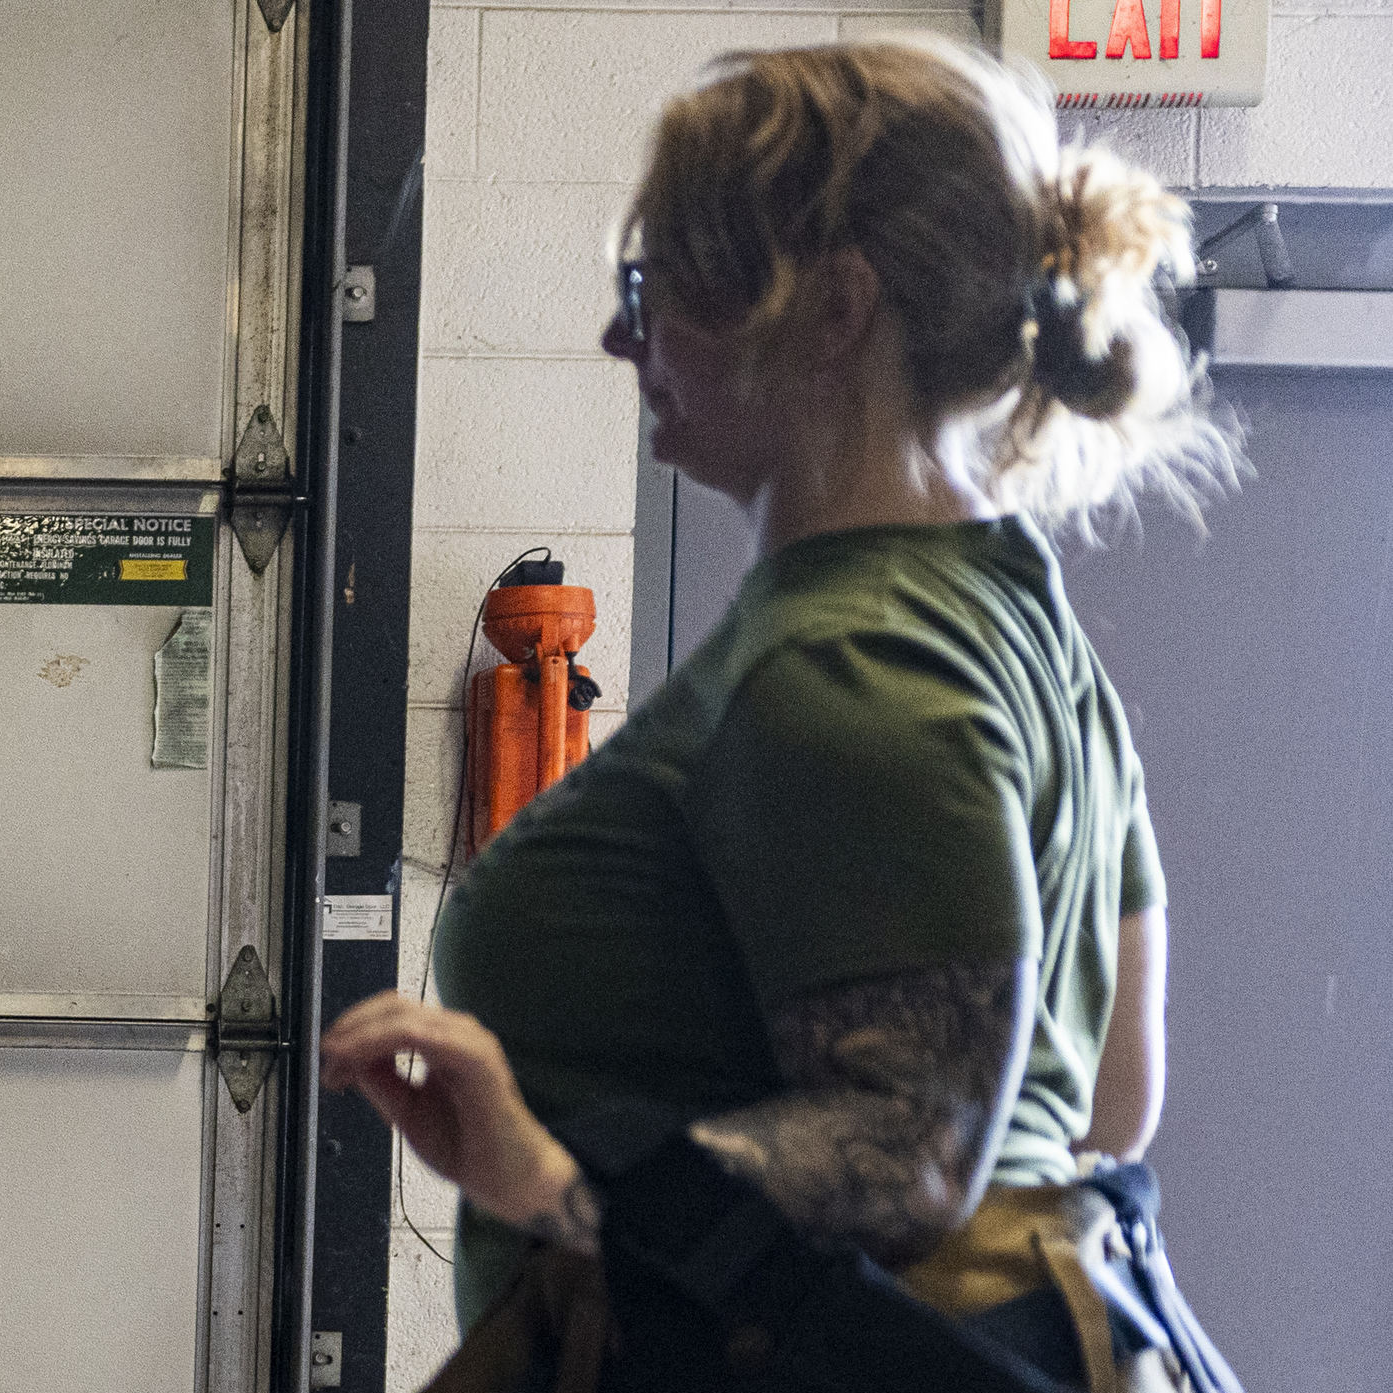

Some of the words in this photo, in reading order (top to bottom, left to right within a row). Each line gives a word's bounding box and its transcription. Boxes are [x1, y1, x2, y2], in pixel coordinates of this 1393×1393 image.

[133, 518, 192, 532] NOTICE
[132, 536, 154, 546] DOOR
[156, 536, 165, 546] IS
[167, 536, 192, 547] FULLY
